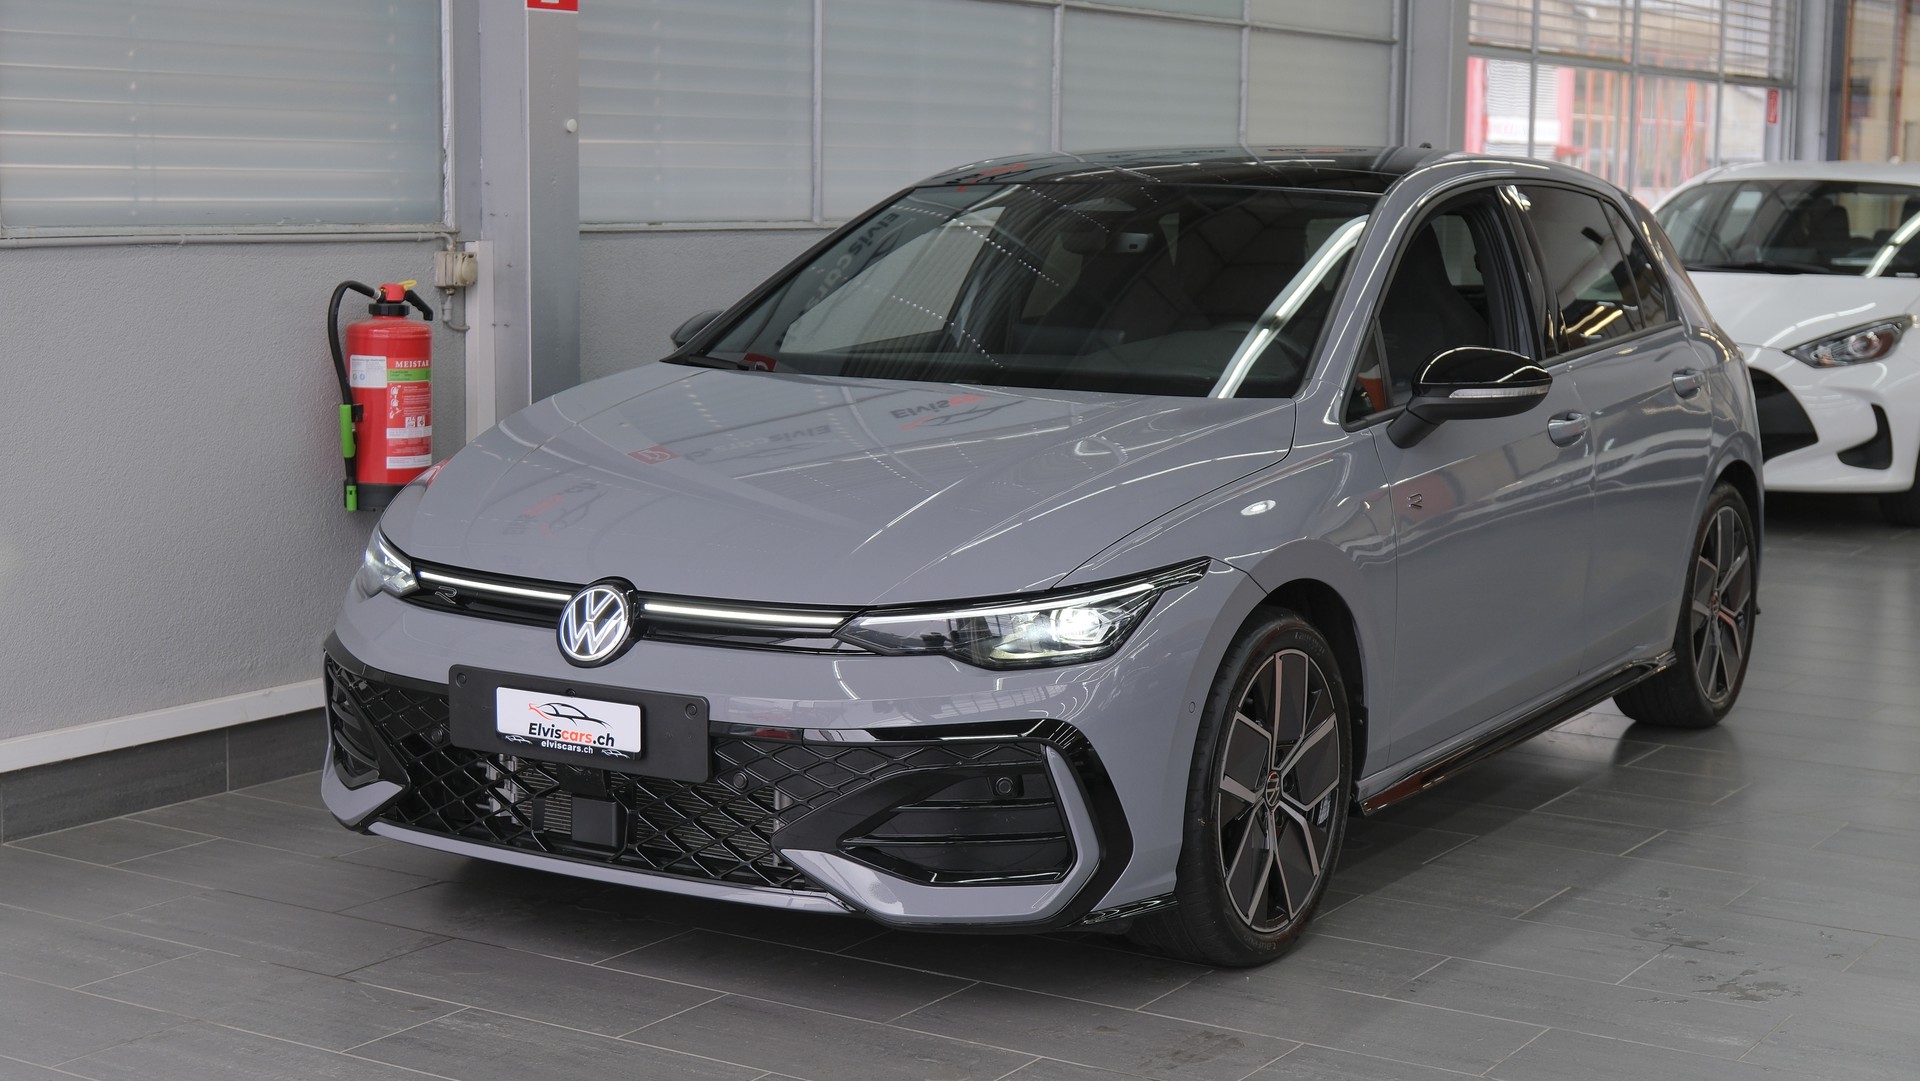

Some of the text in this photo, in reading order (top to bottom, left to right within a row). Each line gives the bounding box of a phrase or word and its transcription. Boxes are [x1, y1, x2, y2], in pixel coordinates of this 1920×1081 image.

[560, 586, 628, 661] VW
[528, 722, 615, 747] Elviscars.ch
[541, 739, 594, 755] elviscars.ch
